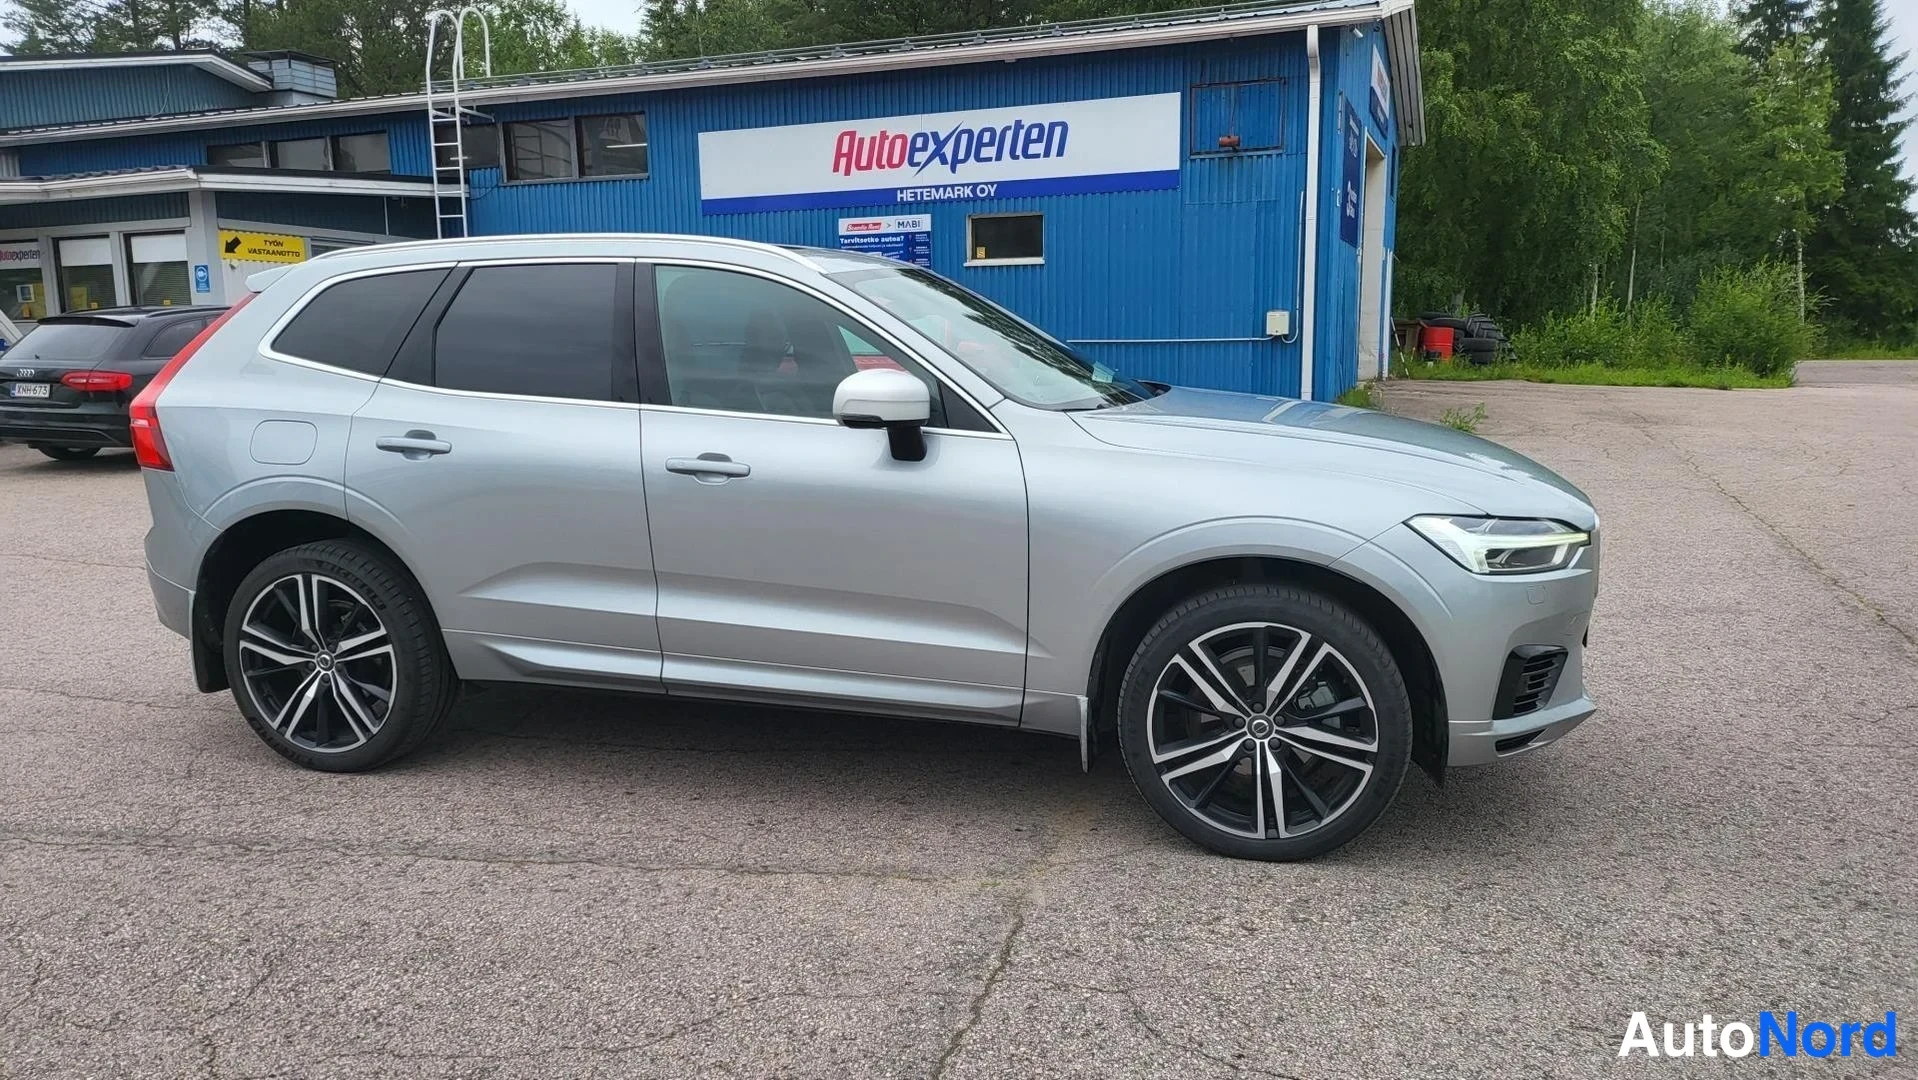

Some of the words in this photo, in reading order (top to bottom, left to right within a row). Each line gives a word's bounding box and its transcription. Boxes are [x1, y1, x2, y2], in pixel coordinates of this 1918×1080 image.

[832, 120, 1069, 177] Autoexperten
[896, 185, 972, 202] HETEMARK
[976, 184, 998, 197] OY
[264, 239, 284, 247] TYÖN
[840, 236, 879, 244] Tarvitsetko
[247, 248, 301, 257] VASTAANOTTO
